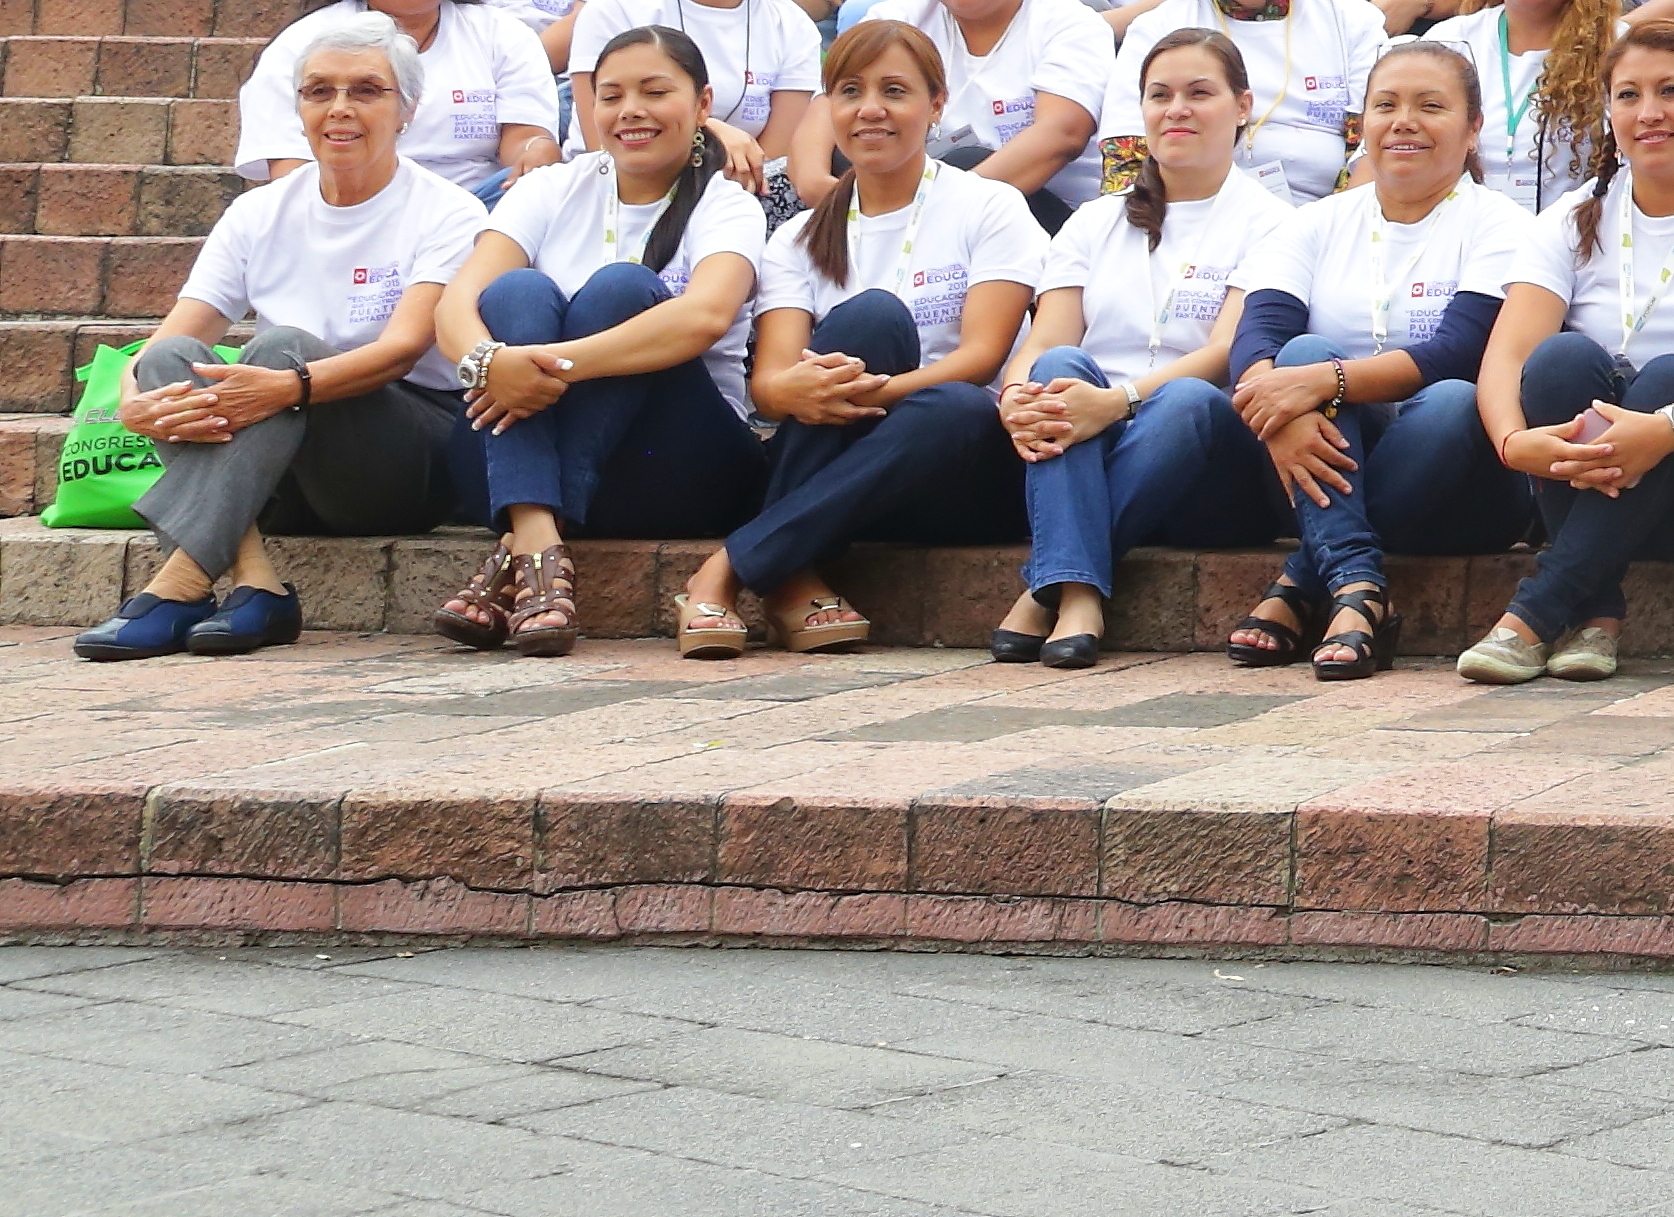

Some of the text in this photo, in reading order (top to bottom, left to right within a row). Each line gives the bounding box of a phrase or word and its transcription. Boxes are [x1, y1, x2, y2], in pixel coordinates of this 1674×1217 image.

[1319, 81, 1347, 90] EDUC
[1006, 101, 1035, 114] EDUC
[926, 271, 968, 284] EDUCA
[1176, 304, 1221, 315] PUENT
[62, 452, 162, 483] EDUCA
